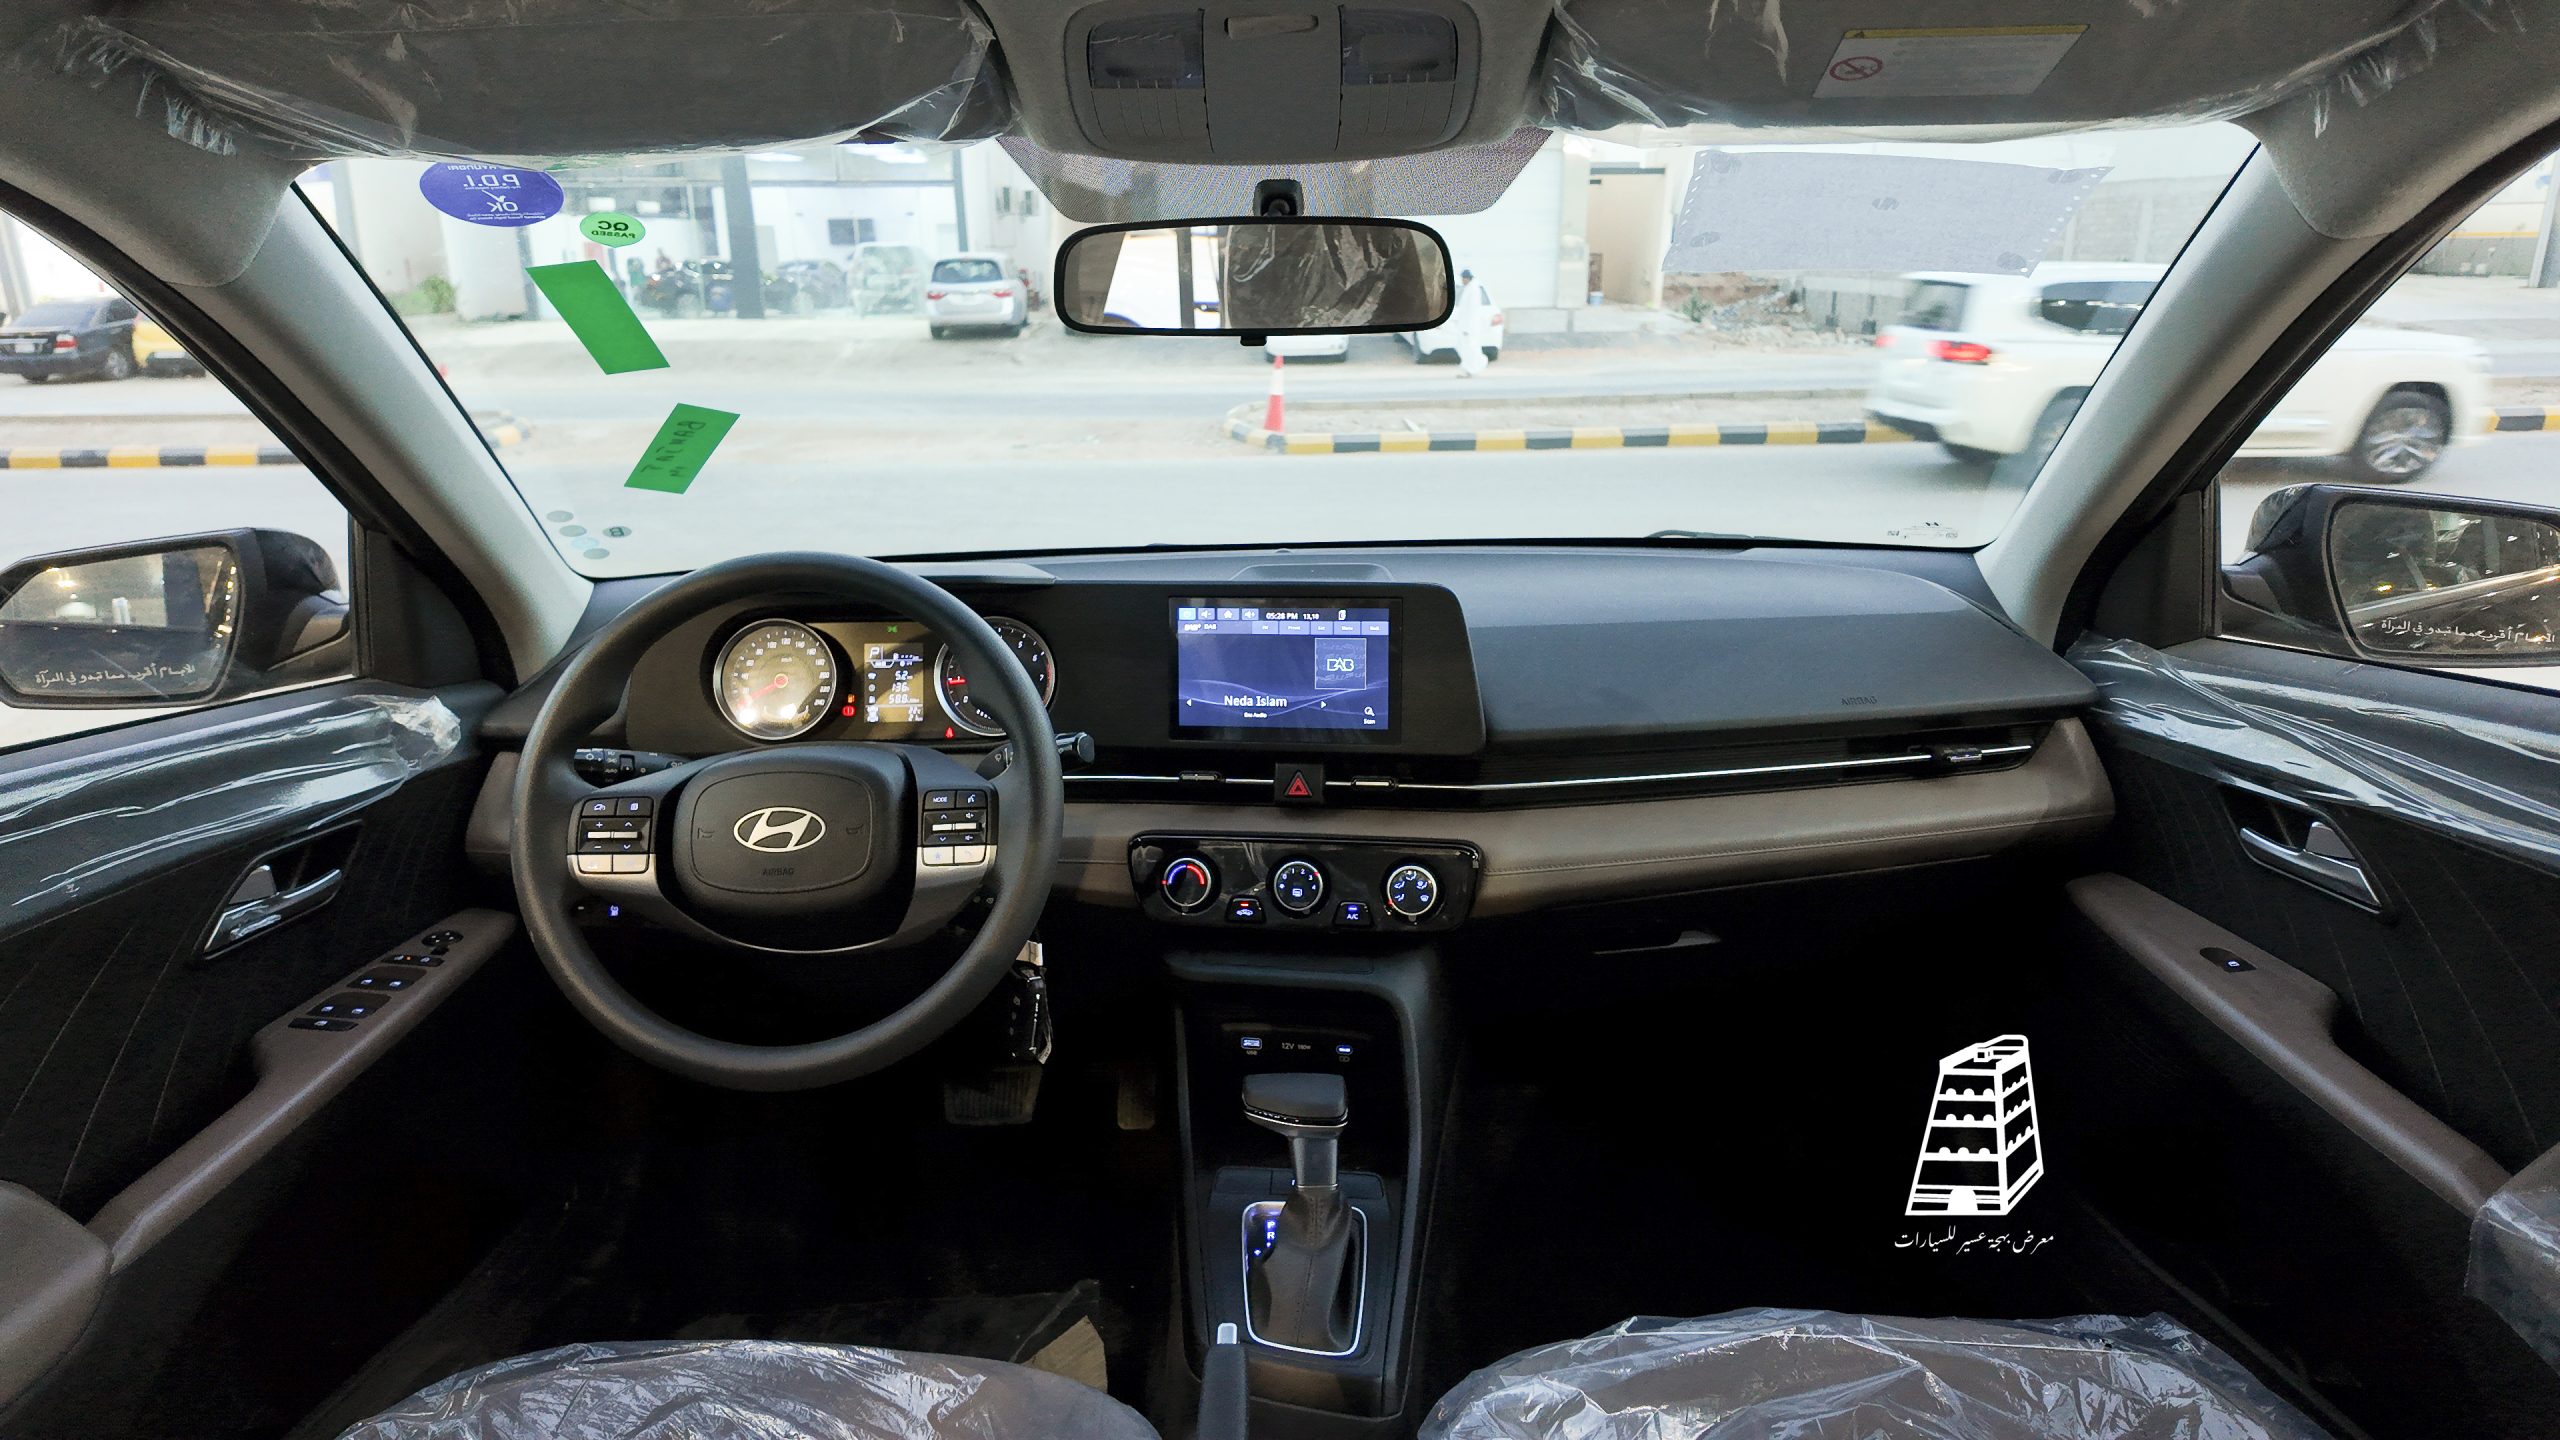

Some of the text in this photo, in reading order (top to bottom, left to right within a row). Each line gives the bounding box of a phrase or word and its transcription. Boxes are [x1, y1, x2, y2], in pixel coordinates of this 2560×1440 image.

[1287, 612, 1299, 620] PM
[2412, 621, 2424, 636] في
[2424, 626, 2451, 637] تبدو
[2455, 626, 2478, 637] مما
[870, 647, 879, 659] P
[1327, 657, 1355, 672] DAB
[66, 671, 77, 686] في
[104, 670, 125, 681] مما
[1224, 696, 1287, 707] Neda Islam
[1841, 695, 1878, 706] AIRBAG
[1282, 1042, 1295, 1050] 12V
[1267, 1231, 1275, 1239] R
